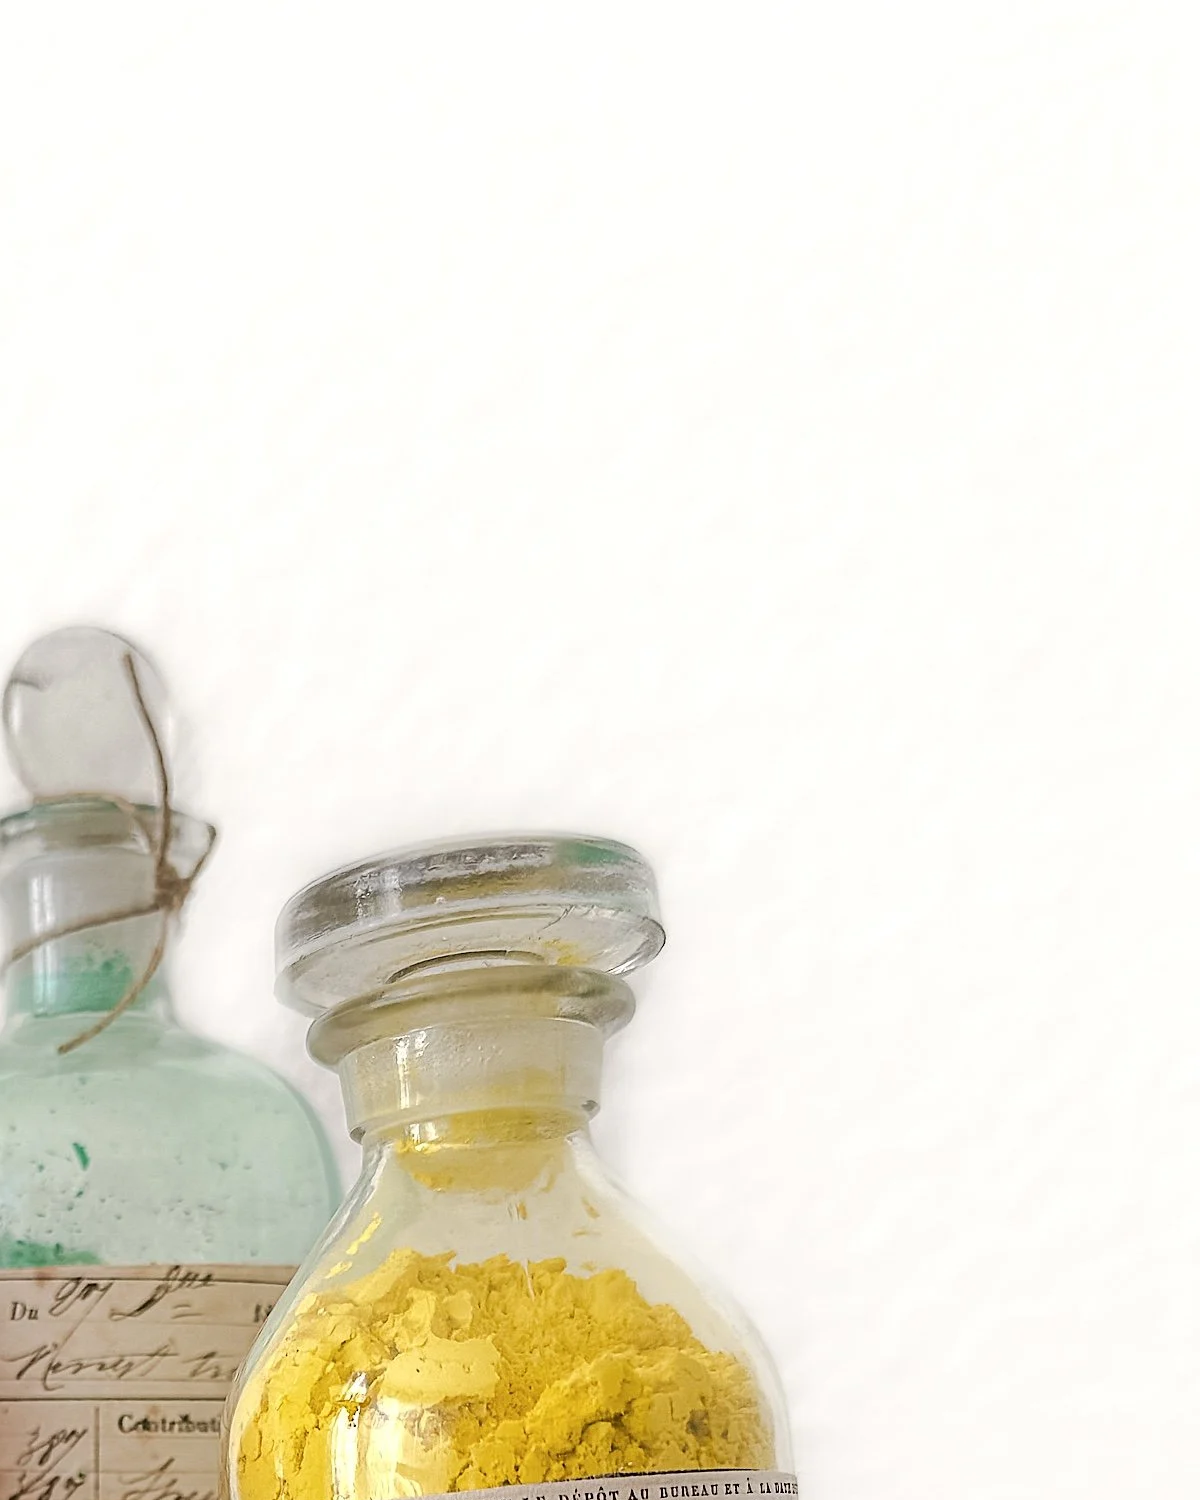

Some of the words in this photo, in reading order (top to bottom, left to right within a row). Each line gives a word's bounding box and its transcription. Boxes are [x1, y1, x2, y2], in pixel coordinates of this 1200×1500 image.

[11, 1301, 39, 1322] Du
[660, 1482, 718, 1499] BUREAU
[725, 1483, 740, 1495] ET
